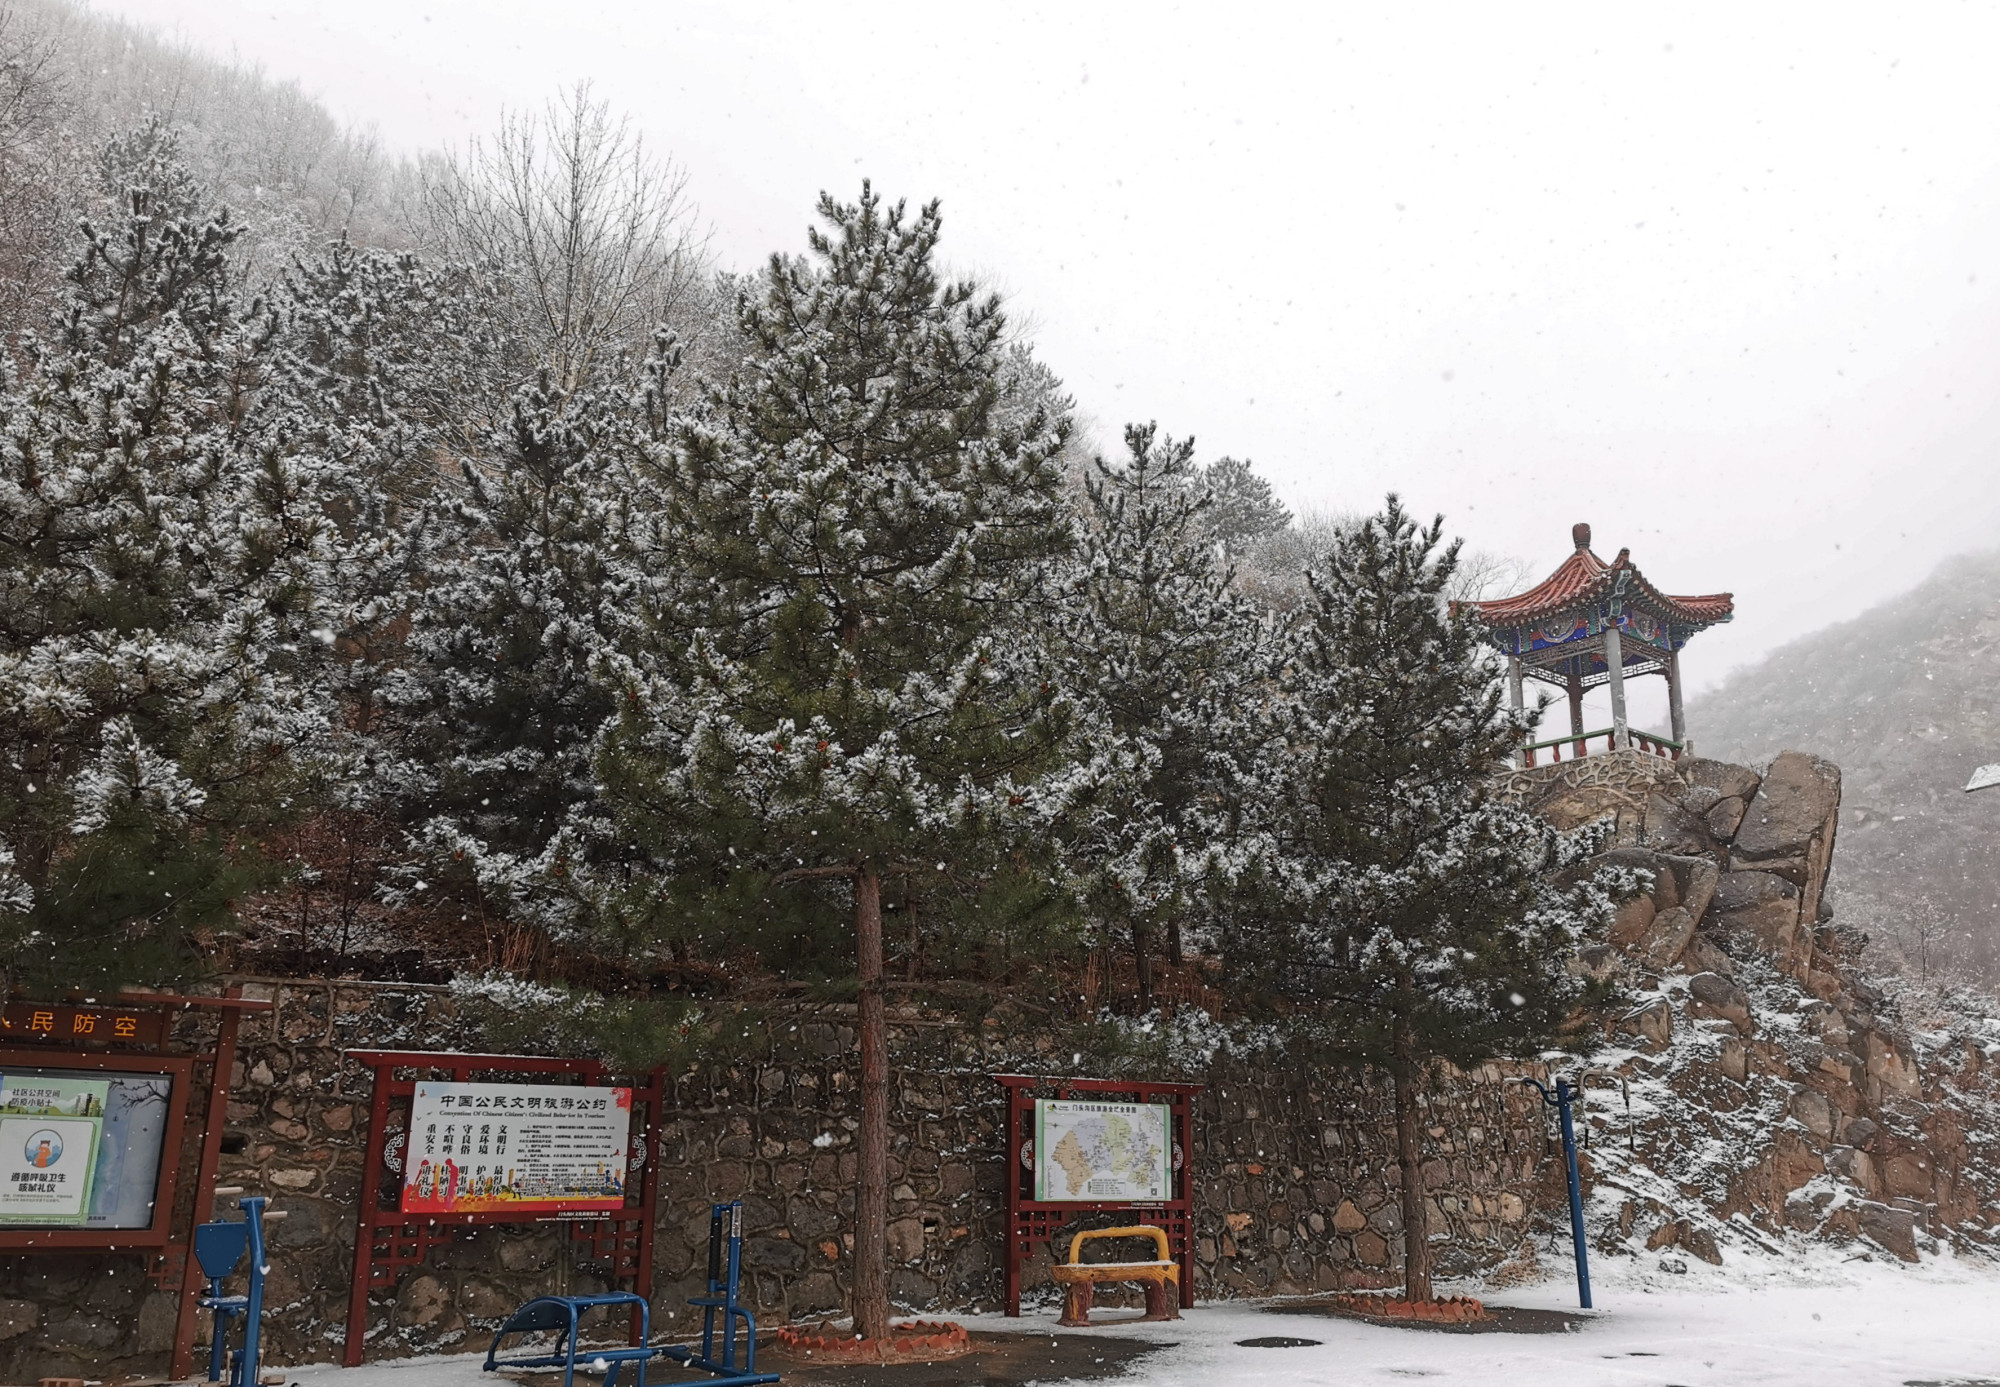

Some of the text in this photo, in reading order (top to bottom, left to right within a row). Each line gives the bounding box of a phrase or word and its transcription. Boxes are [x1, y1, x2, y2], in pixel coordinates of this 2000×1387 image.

[1, 1011, 137, 1037] 民防空
[11, 1098, 53, 1107] 防疫小贴士
[12, 1088, 60, 1098] 社区公共空间
[440, 1095, 607, 1110] 中国公民文明旅游公约
[442, 1124, 455, 1155] 不喧哗
[460, 1124, 473, 1155] 守良俗
[478, 1124, 490, 1155] 爱环境
[496, 1124, 508, 1155] 文明行
[11, 1172, 66, 1183] 遵循呼吸卫生
